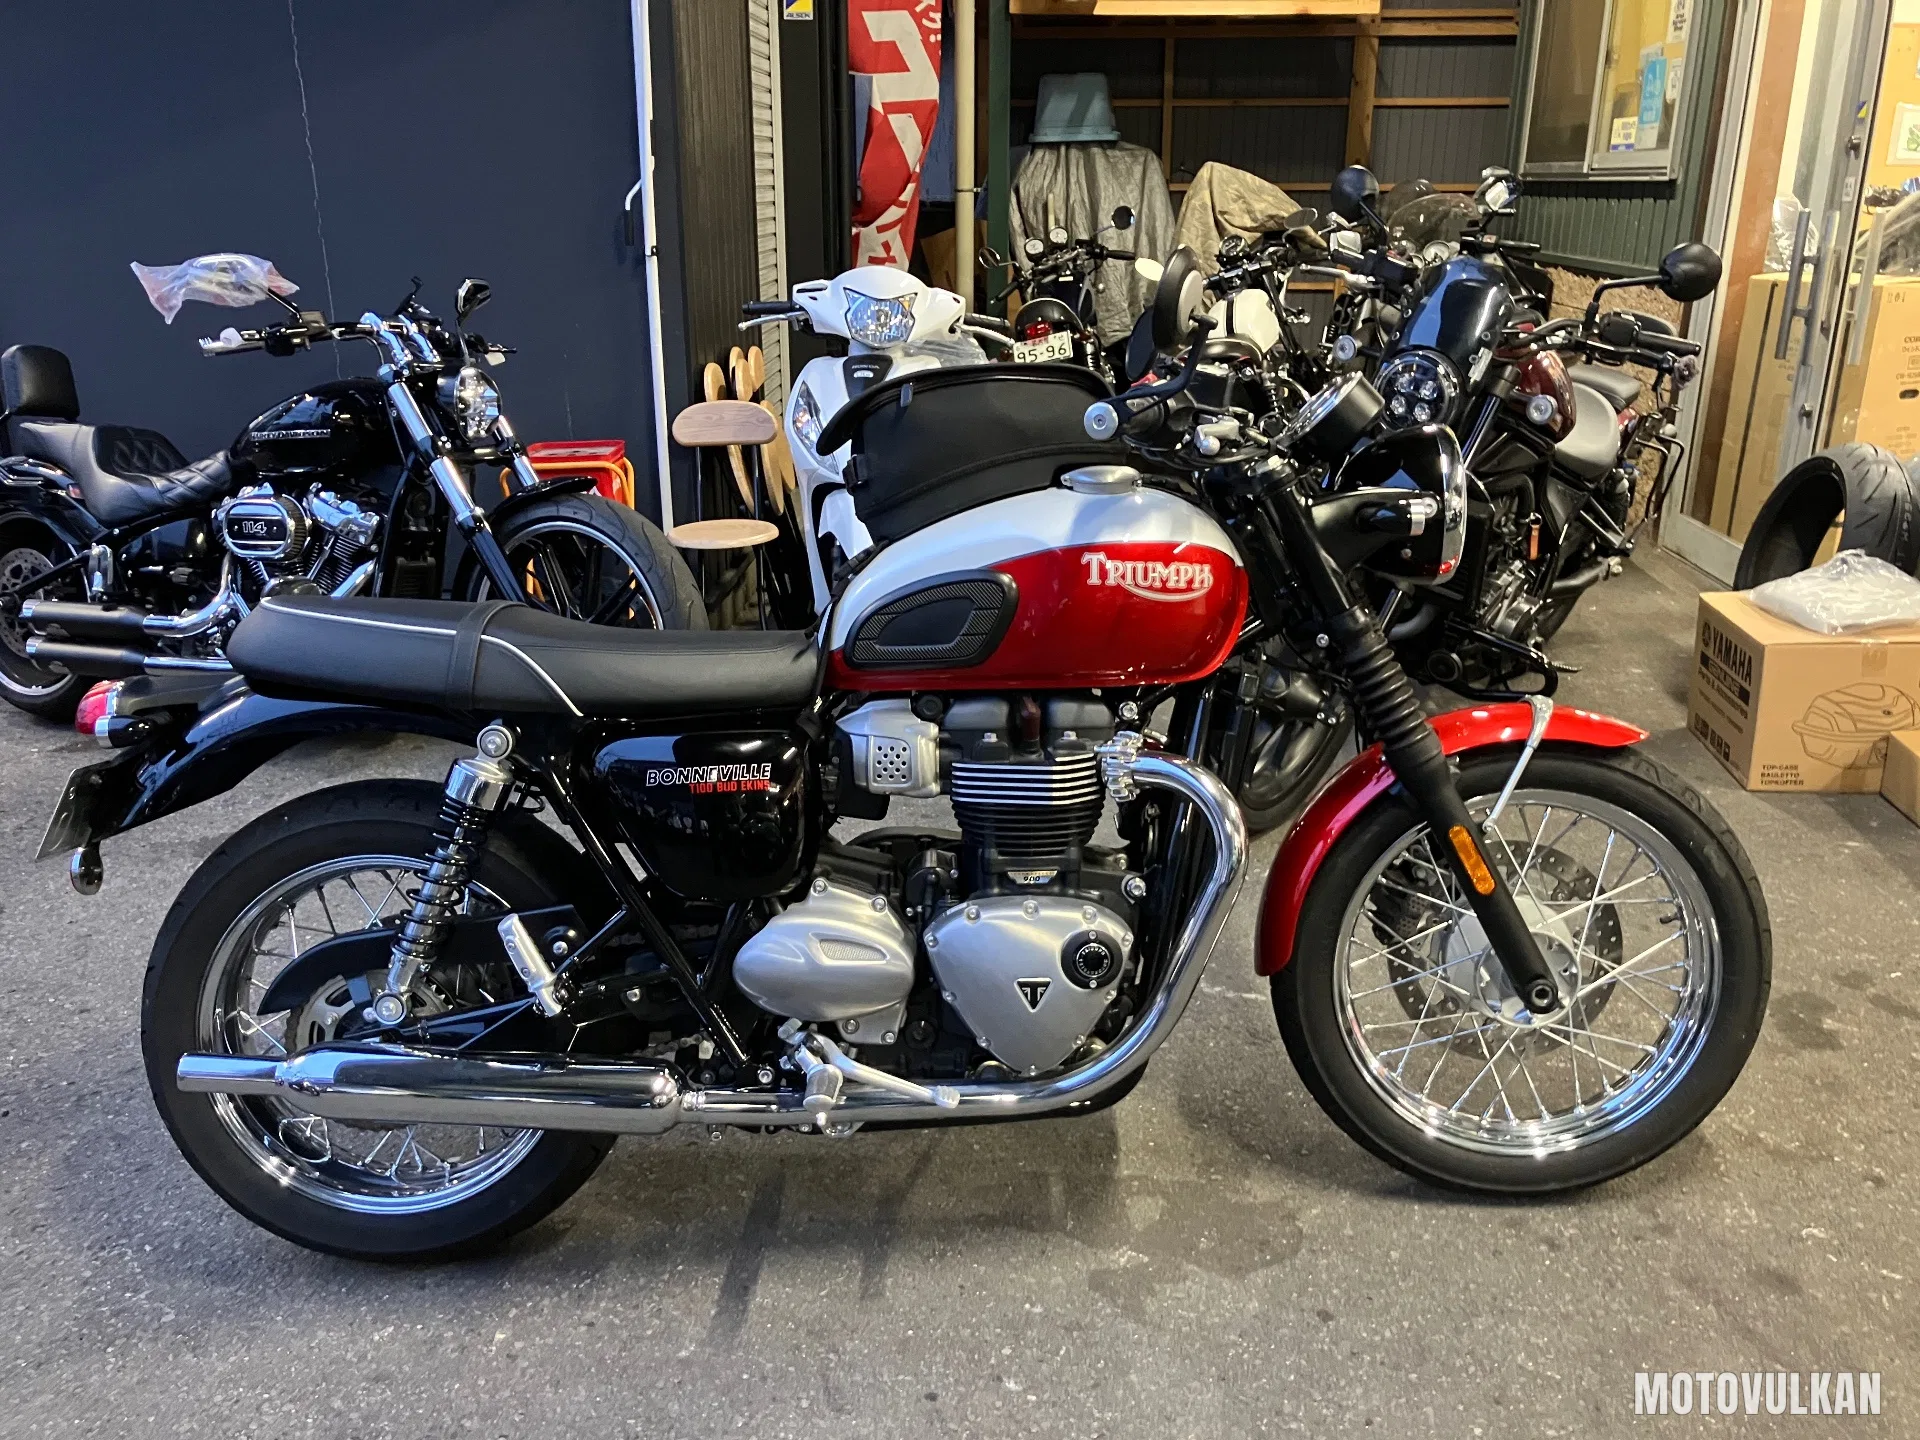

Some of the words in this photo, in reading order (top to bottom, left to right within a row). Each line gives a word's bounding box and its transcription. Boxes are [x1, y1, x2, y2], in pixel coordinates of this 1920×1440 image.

[1017, 343, 1067, 362] 95-96
[242, 521, 267, 533] 114
[1080, 551, 1214, 600] TRIUMPH
[1712, 626, 1752, 686] YAMAHA
[646, 763, 772, 787] BONNEVILLE
[690, 782, 713, 793] T100
[716, 781, 738, 792] BUD
[740, 780, 771, 791] EKINS
